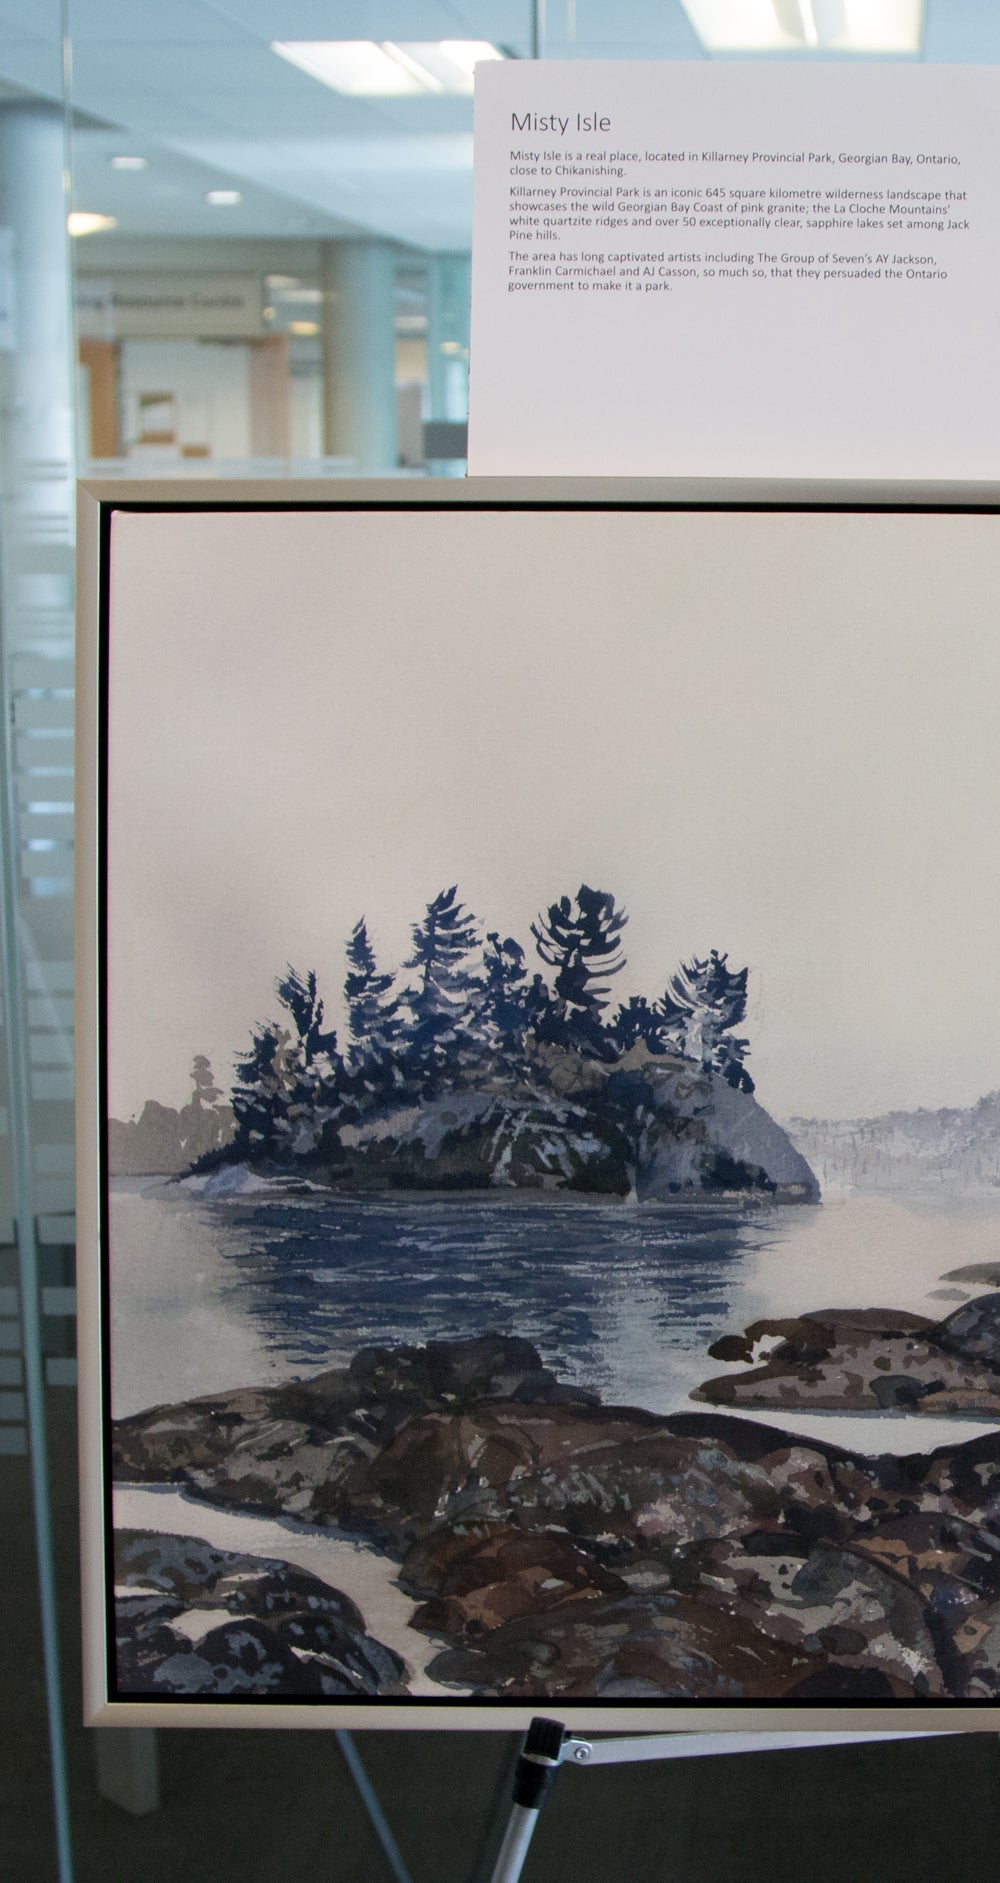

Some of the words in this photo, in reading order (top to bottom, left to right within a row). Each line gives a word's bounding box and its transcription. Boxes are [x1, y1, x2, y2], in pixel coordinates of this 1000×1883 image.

[511, 112, 570, 137] Misty
[577, 111, 611, 132] Isle
[510, 150, 541, 164] Misty
[543, 149, 562, 161] Isle
[564, 150, 573, 161] is
[575, 152, 583, 161] a
[585, 150, 607, 162] real
[609, 150, 642, 164] place,
[645, 150, 685, 162] located
[688, 151, 699, 162] in
[701, 151, 749, 165] Killarney
[752, 151, 805, 163] Provincial
[808, 152, 835, 165] Park,
[838, 152, 888, 166] Georgian
[891, 153, 913, 166] Bay,
[916, 153, 961, 167] Ontario,
[509, 164, 538, 176] close
[540, 165, 553, 176] to
[554, 164, 627, 178] Chikanishing.
[509, 185, 557, 200] Killarney
[559, 186, 613, 198] Provincial
[616, 186, 640, 198] Park
[642, 186, 652, 198] is
[654, 189, 668, 198] an
[671, 187, 703, 198] iconic
[705, 187, 726, 199] 645
[729, 189, 767, 201] square
[769, 187, 822, 199] kilometre
[824, 188, 884, 200] wilderness
[886, 188, 942, 203] landscape
[944, 189, 967, 201] that
[509, 200, 568, 212] showcases
[570, 200, 589, 212] the
[591, 200, 615, 212] wild
[617, 201, 668, 215] Georgian
[670, 201, 691, 215] Bay
[692, 201, 724, 213] Coast
[726, 201, 739, 213] of
[740, 201, 765, 215] pink
[766, 202, 809, 216] granite;
[812, 202, 831, 214] the
[834, 203, 846, 214] La
[848, 202, 886, 215] Cloche
[509, 215, 541, 226] white
[542, 215, 593, 229] quartzite
[595, 215, 629, 229] ridges
[631, 215, 653, 227] and
[654, 218, 680, 227] over
[682, 216, 697, 227] 50
[699, 216, 772, 230] exceptionally
[774, 216, 803, 230] clear,
[806, 217, 854, 231] sapphire
[856, 217, 884, 229] lakes
[887, 219, 904, 229] set
[906, 220, 945, 232] among
[947, 219, 970, 230] Jack
[509, 229, 533, 241] Pine
[535, 229, 561, 241] hills.
[508, 250, 529, 262] The
[531, 253, 556, 262] area
[559, 250, 578, 262] has
[581, 251, 605, 265] long
[607, 251, 665, 264] captivated
[667, 252, 702, 263] artists
[704, 251, 755, 266] including
[757, 252, 778, 264] The
[780, 252, 815, 266] Group
[817, 252, 830, 264] of
[875, 253, 890, 264] AY
[891, 253, 937, 266] Jackson,
[508, 265, 552, 276] Franklin
[554, 265, 616, 277] Carmichael
[619, 265, 640, 277] and
[642, 266, 655, 277] AJ
[658, 266, 700, 279] Casson,
[703, 268, 716, 277] so
[718, 266, 749, 278] much
[752, 269, 767, 279] so,
[770, 266, 793, 278] that
[796, 266, 821, 280] they
[823, 267, 882, 280] persuaded
[884, 268, 903, 279] the
[905, 268, 948, 280] Ontario
[507, 281, 575, 293] government
[577, 281, 590, 291] to
[592, 280, 622, 291] make
[625, 280, 633, 291] it
[635, 282, 642, 291] a
[645, 280, 673, 293] park.
